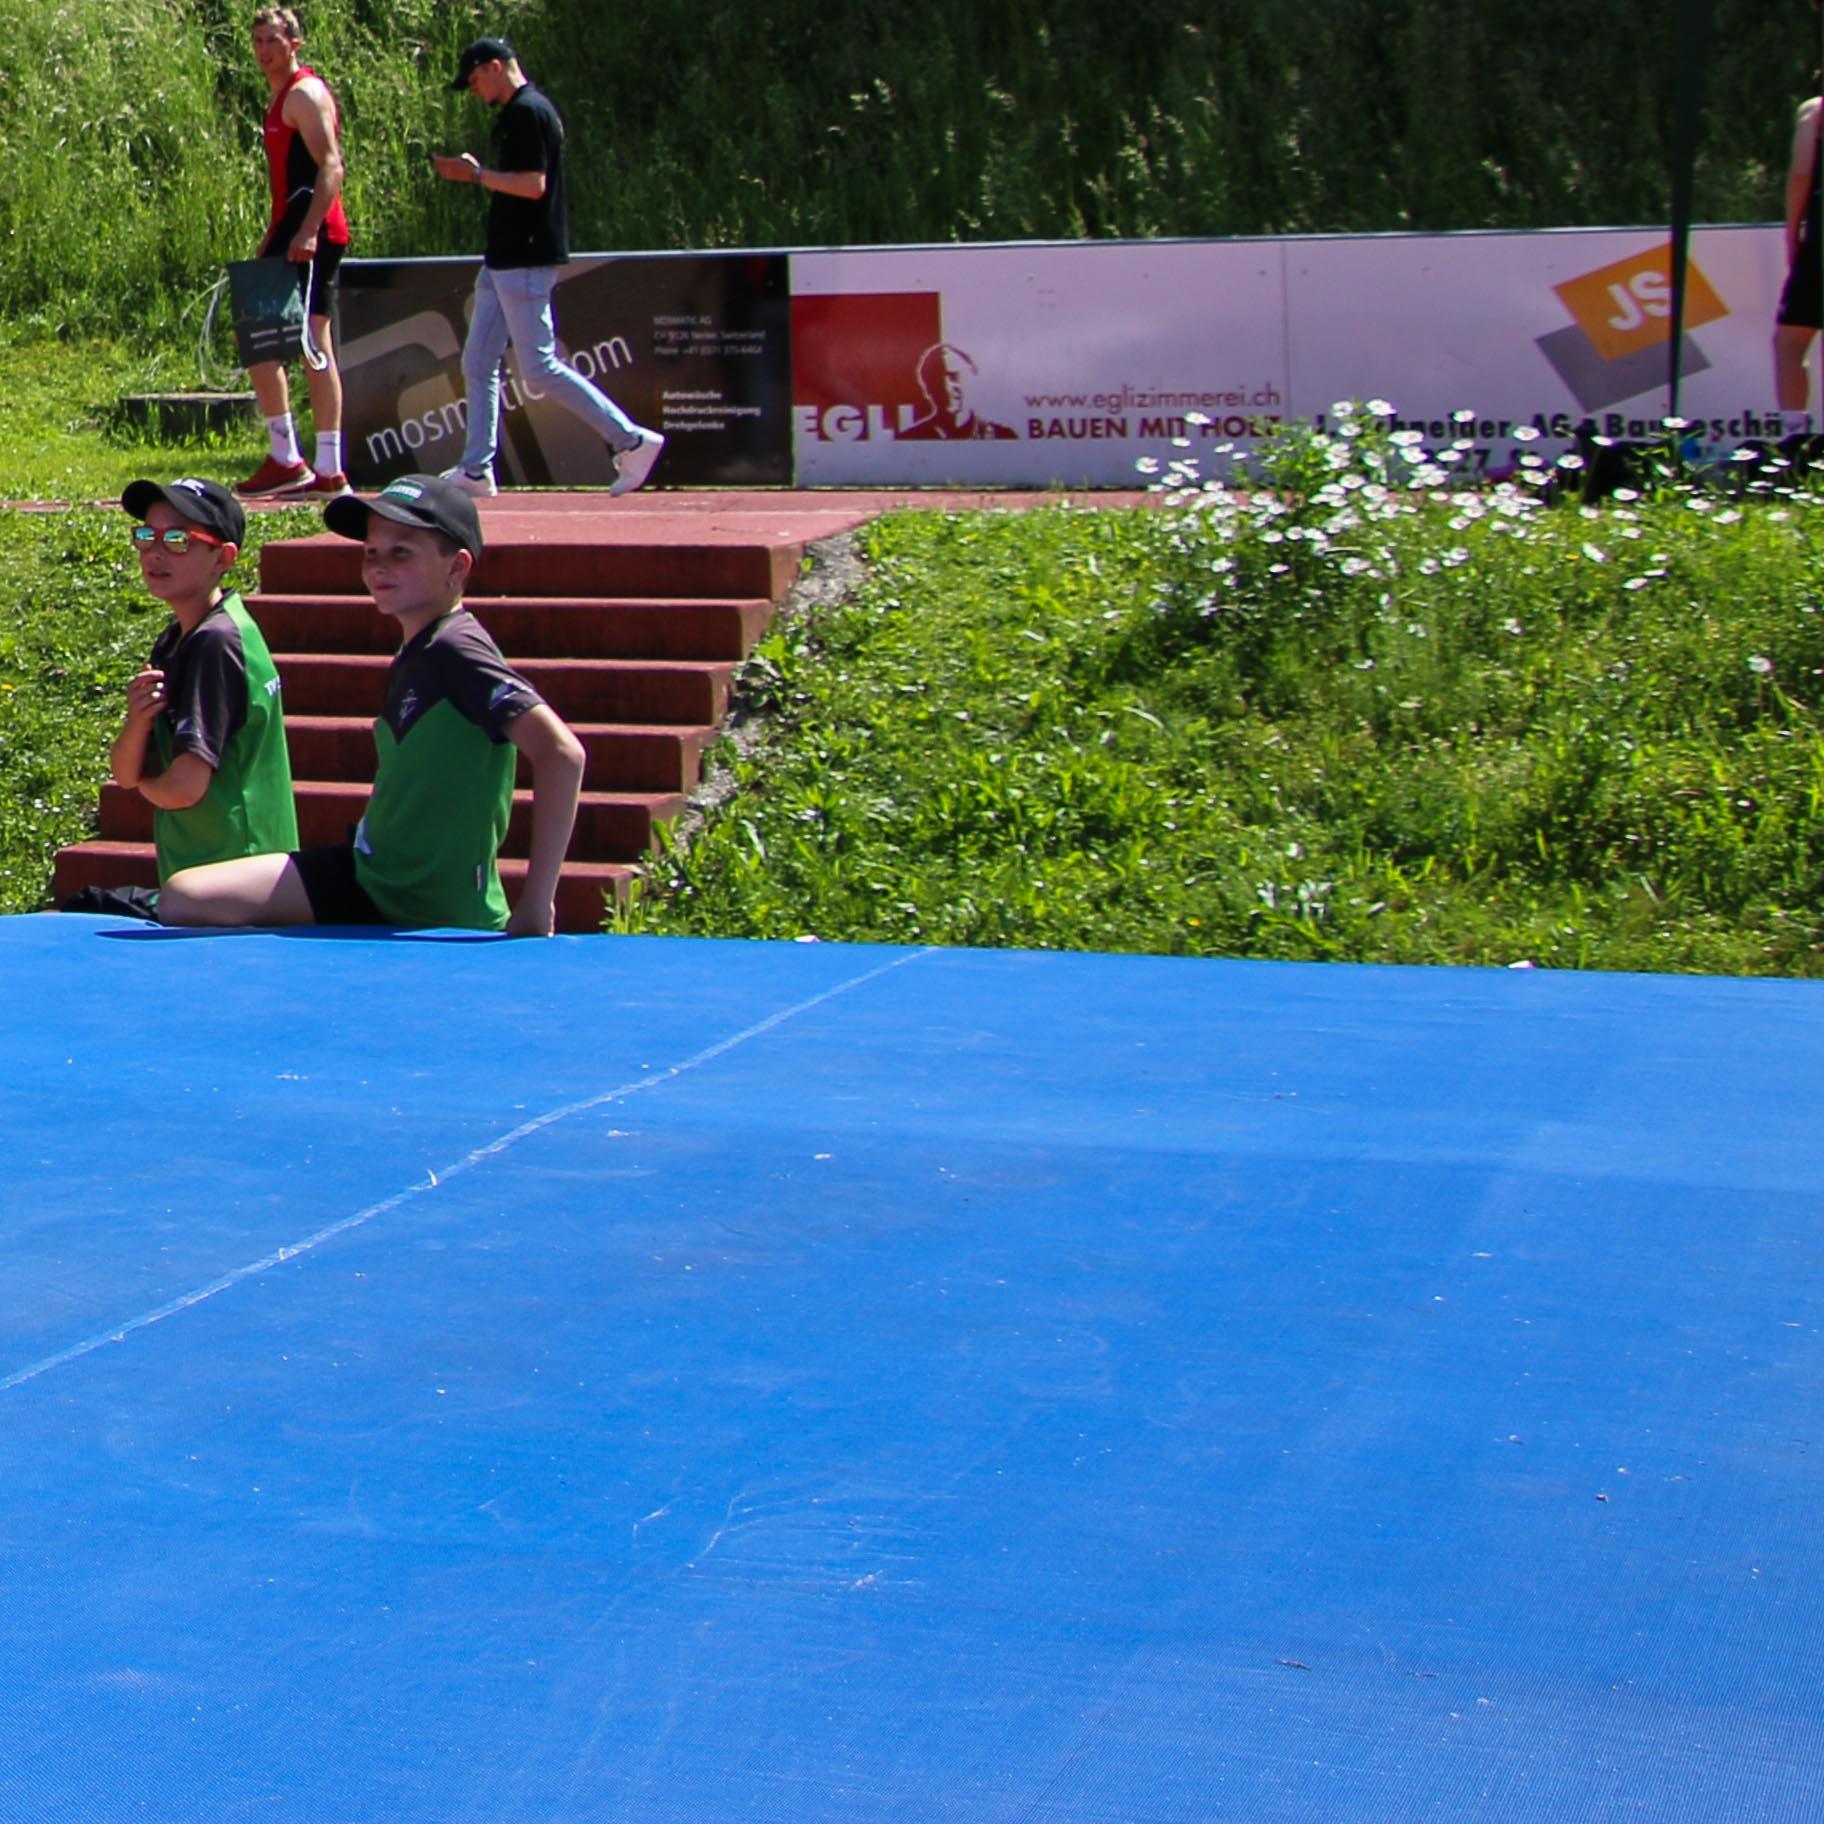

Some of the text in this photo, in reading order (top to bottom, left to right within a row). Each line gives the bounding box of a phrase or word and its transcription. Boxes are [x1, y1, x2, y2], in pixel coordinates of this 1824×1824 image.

[1607, 269, 1672, 331] JS
[1024, 382, 1280, 414] www.eglizimmerei.ch
[1028, 418, 1127, 439] BAUEN
[1138, 417, 1186, 438] MIT
[1374, 413, 1512, 439] chneider
